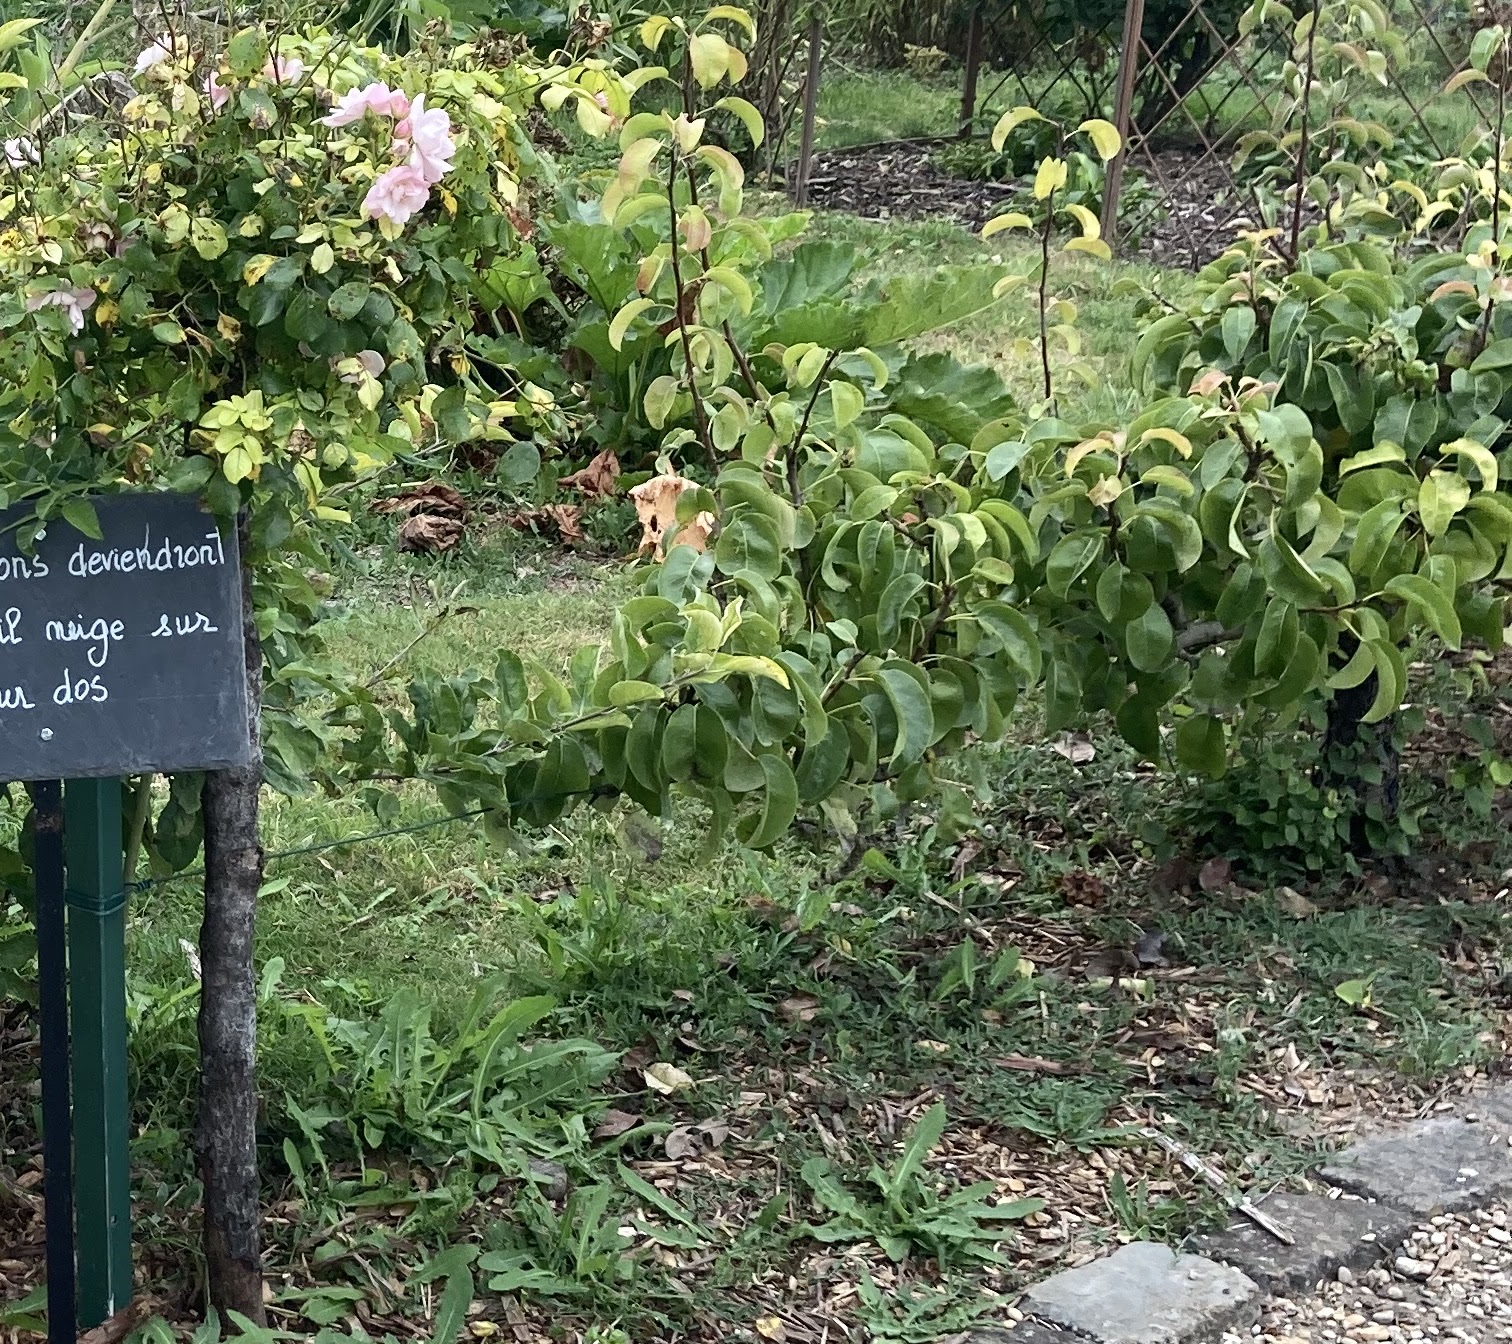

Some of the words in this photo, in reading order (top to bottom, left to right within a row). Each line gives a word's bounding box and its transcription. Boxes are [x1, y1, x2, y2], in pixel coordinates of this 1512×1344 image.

[68, 522, 225, 577] deviendront
[46, 613, 125, 668] neige
[151, 611, 219, 638] sur
[53, 668, 108, 704] dos
